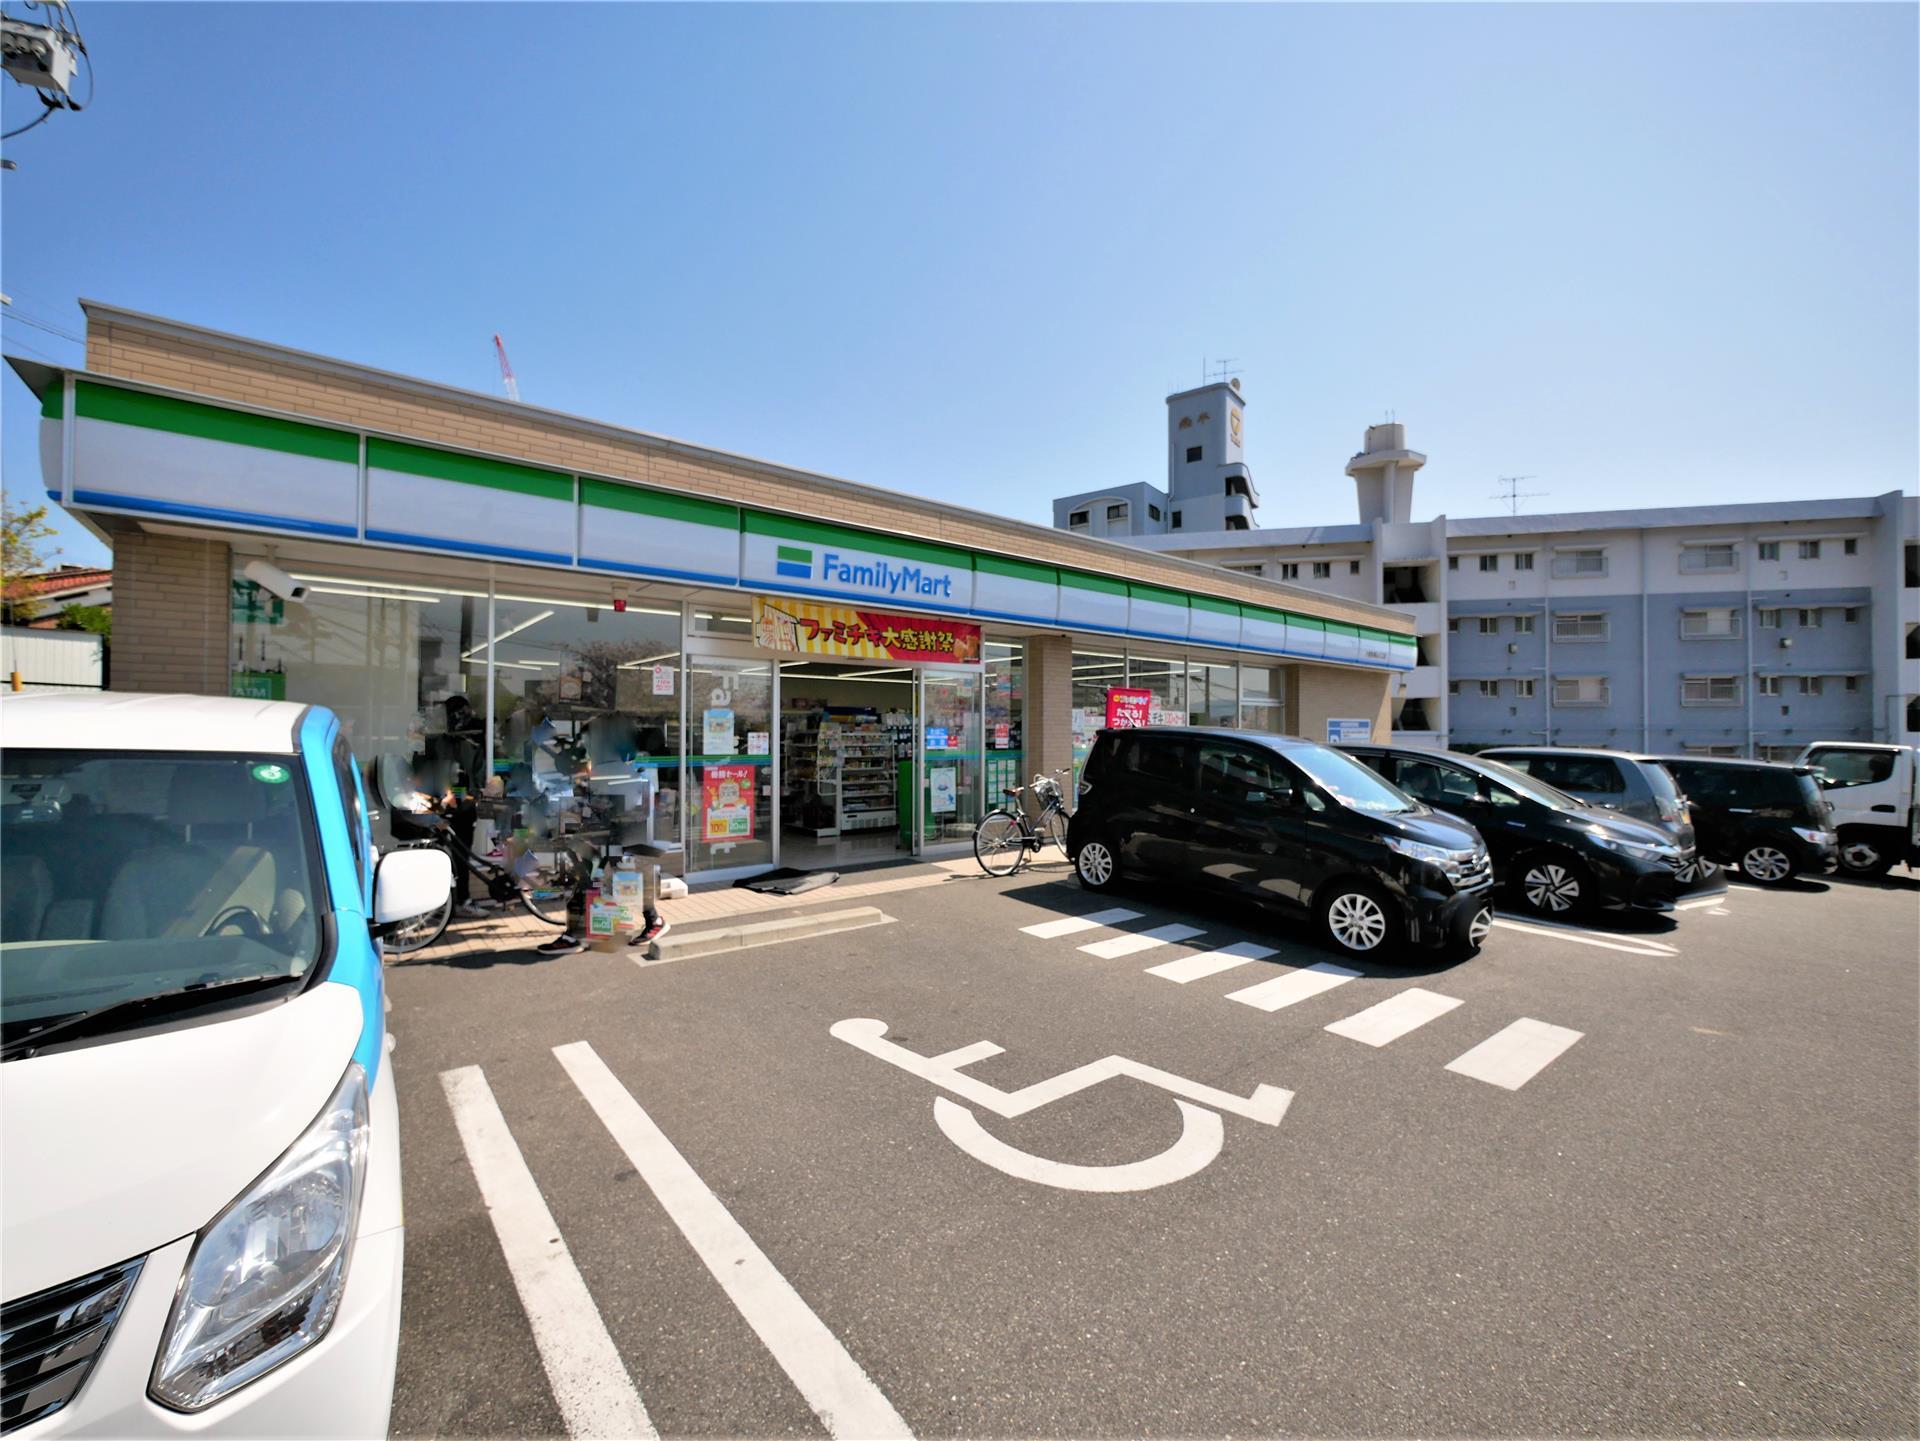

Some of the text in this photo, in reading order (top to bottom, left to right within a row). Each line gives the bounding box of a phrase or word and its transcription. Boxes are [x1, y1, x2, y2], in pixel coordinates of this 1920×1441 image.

[823, 552, 951, 597] FamilyMart
[798, 617, 955, 653] ファミチキ大感謝祭
